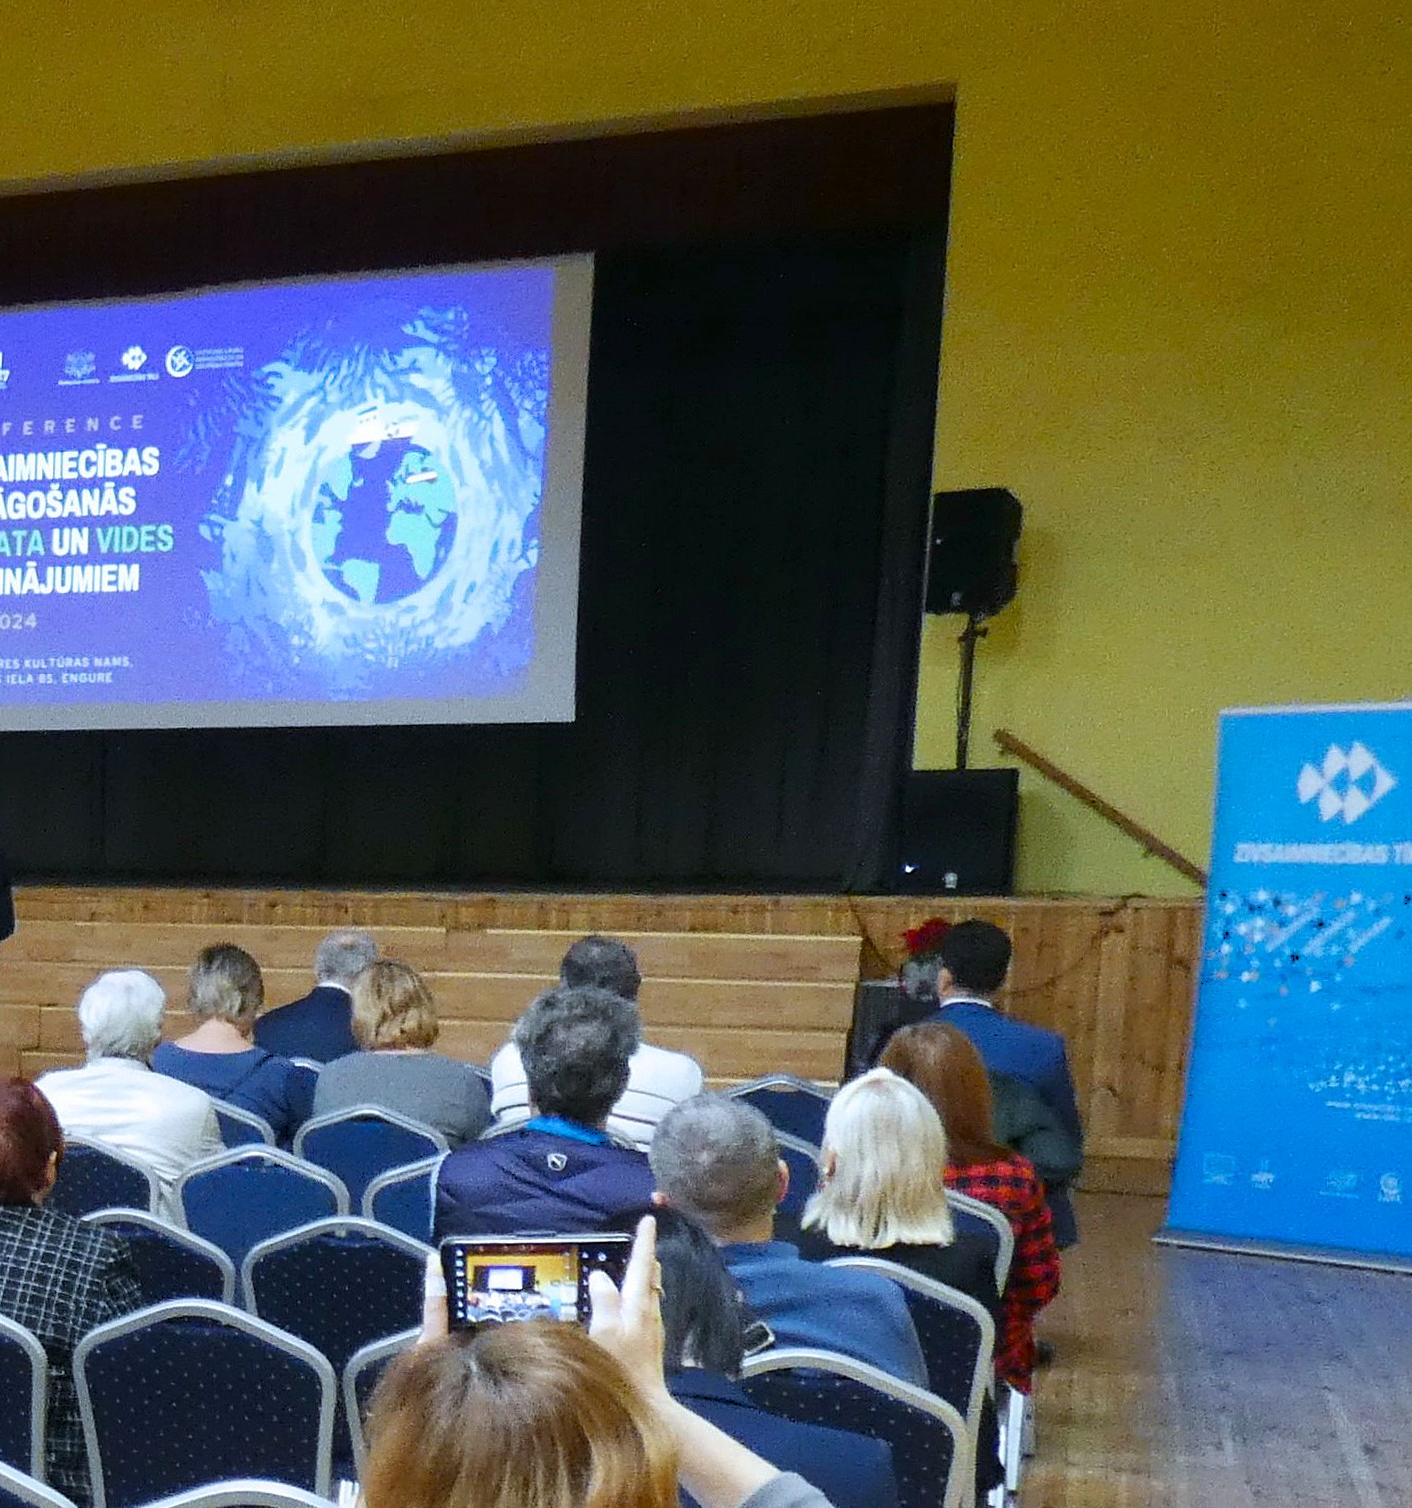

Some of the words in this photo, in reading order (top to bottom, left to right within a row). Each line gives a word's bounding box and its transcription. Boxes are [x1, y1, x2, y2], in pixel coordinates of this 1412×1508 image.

[51, 527, 90, 556] UN
[96, 524, 174, 553] VIDES
[61, 671, 113, 684] ENGURE
